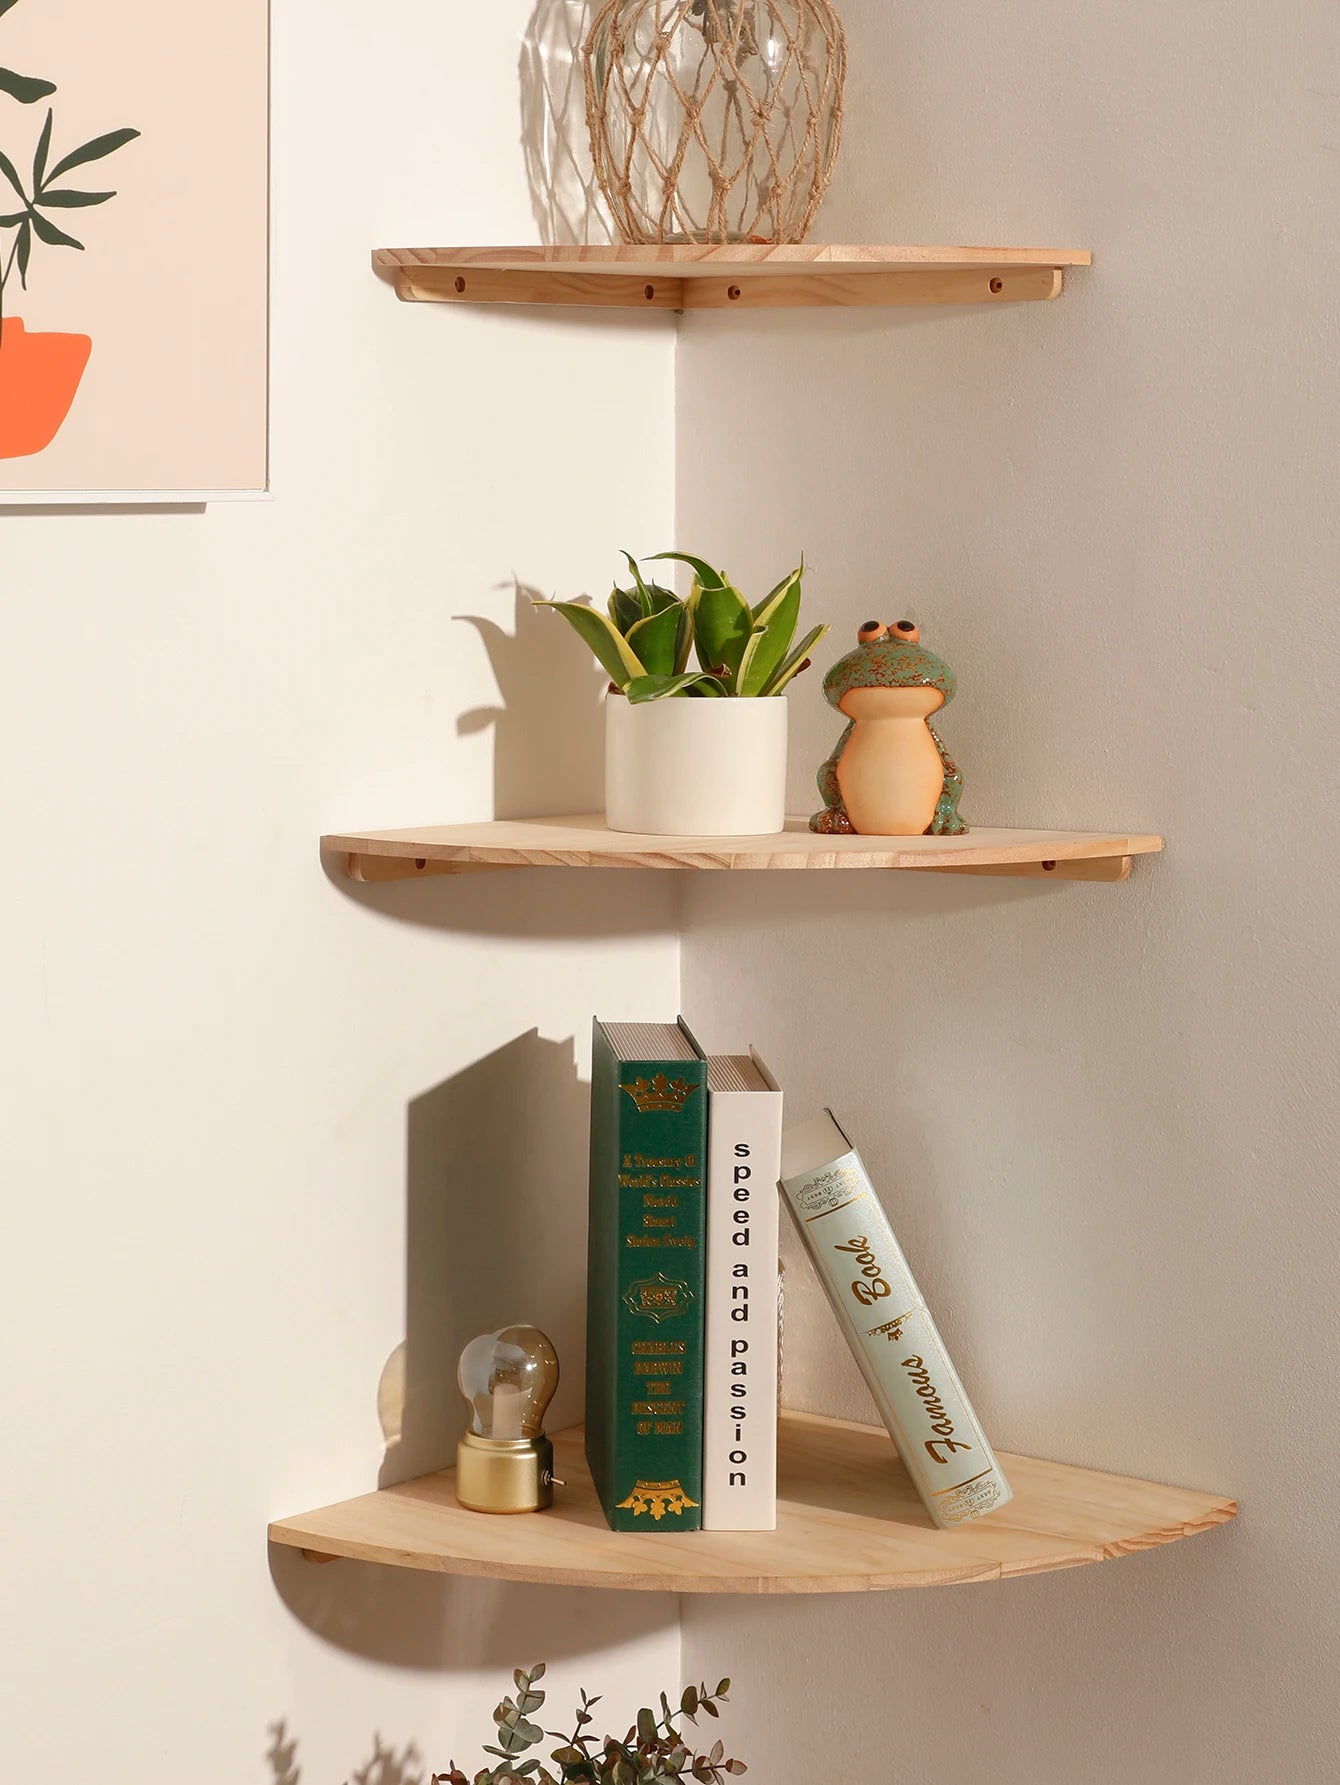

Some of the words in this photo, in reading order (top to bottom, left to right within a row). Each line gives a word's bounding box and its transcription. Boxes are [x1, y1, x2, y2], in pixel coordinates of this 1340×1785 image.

[623, 1154, 632, 1168] A
[634, 1154, 681, 1170] Treasury
[618, 1174, 657, 1188] World's
[660, 1173, 701, 1188] Classics
[732, 1143, 752, 1246] speed
[834, 1235, 891, 1306] Book
[731, 1263, 749, 1322] and
[634, 1361, 683, 1375] DARWIN
[646, 1381, 671, 1395] THE
[631, 1401, 685, 1415] DESCENT
[729, 1339, 749, 1486] passion
[901, 1354, 972, 1464] Famous
[637, 1421, 652, 1435] OF
[654, 1421, 683, 1435] MAN
